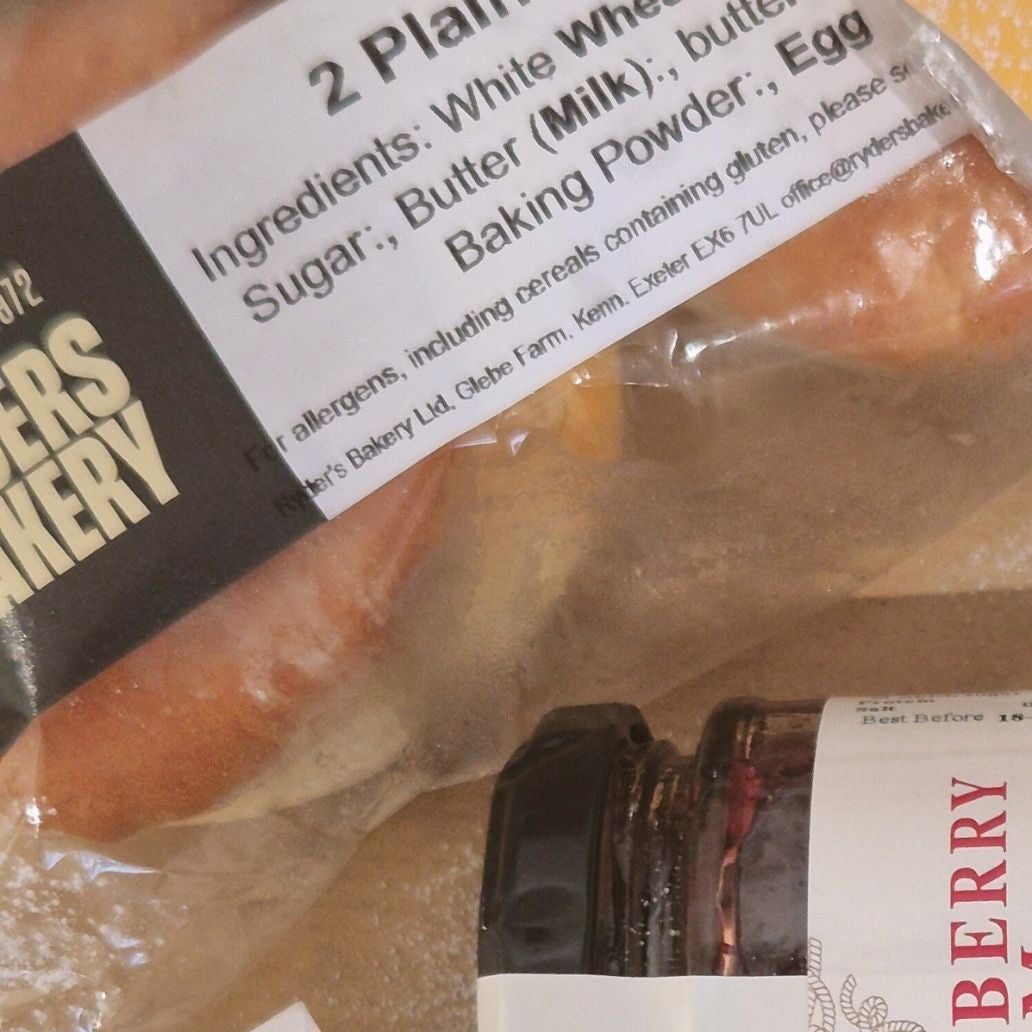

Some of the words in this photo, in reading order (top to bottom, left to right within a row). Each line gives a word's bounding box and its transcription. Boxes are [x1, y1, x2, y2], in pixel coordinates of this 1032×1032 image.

[192, 125, 433, 283] Ingredients:
[429, 51, 557, 133] White
[243, 226, 399, 323] Sugar:,
[394, 137, 522, 231] Butter
[529, 58, 680, 154] (Milk):,
[308, 61, 362, 117] 2
[444, 168, 595, 273] Baking
[590, 71, 779, 184] Powder:,
[774, 10, 874, 77] Egg
[290, 364, 409, 443] allergens,
[403, 296, 515, 369] including
[514, 242, 601, 305] cereals
[603, 170, 725, 253] containing
[726, 127, 808, 184] gluten,
[807, 75, 887, 137] please
[345, 417, 414, 469] Bakery
[454, 360, 515, 401] Glebe
[627, 250, 692, 299] Exeter
[689, 224, 736, 262] EX6
[735, 203, 779, 236] 7UL
[862, 713, 906, 725] Best
[914, 712, 984, 723] Before
